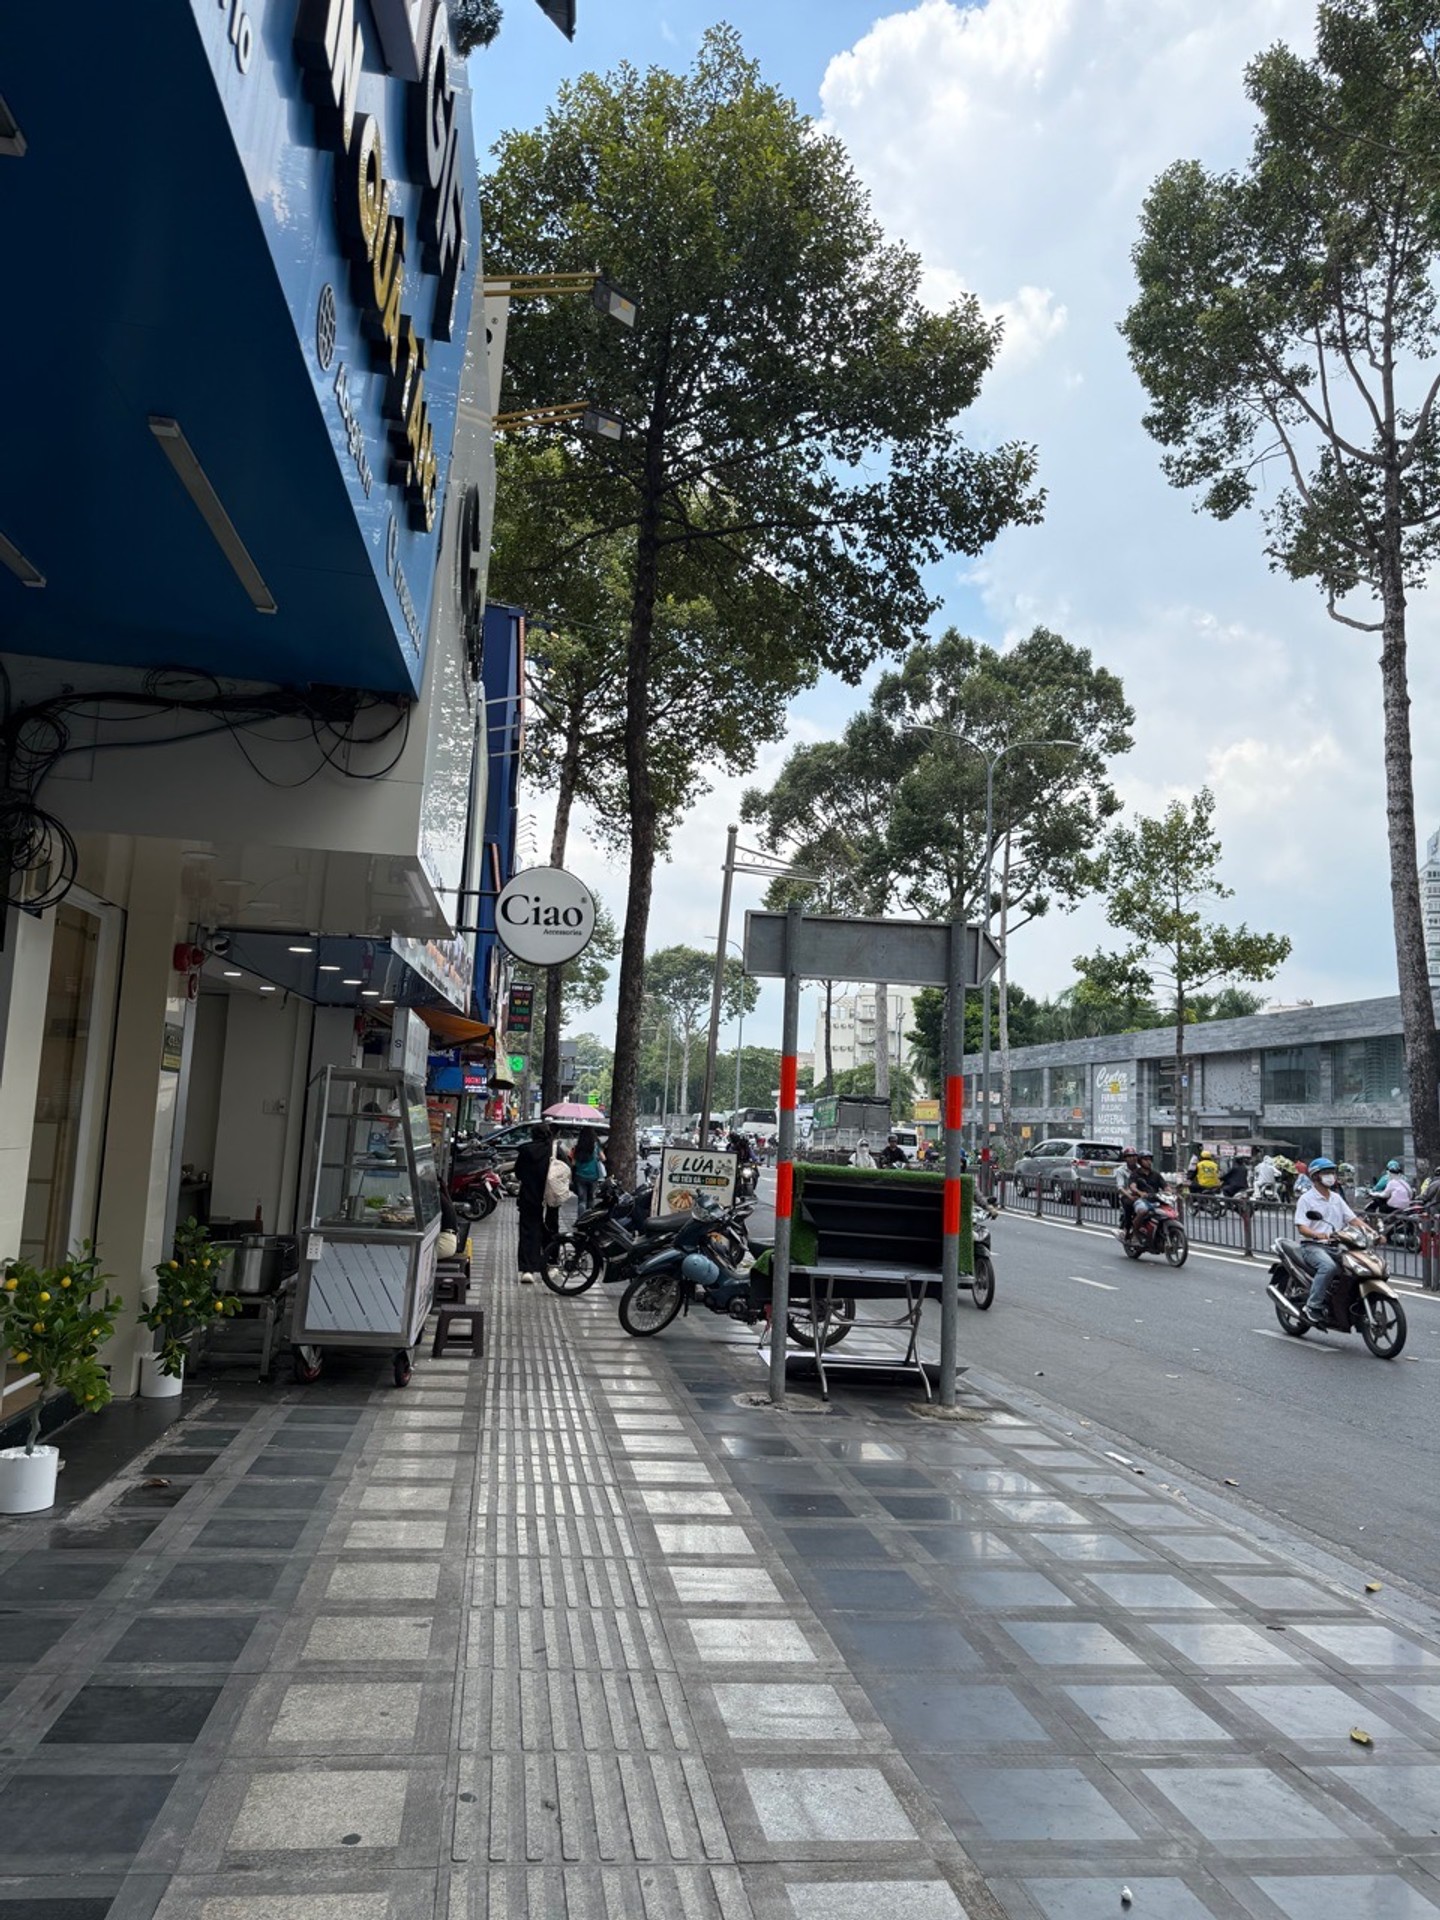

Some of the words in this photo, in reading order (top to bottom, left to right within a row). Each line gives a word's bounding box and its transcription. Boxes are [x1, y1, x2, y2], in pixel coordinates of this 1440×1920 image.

[501, 894, 583, 927] Ciao
[543, 928, 582, 936] Accessories
[682, 1155, 714, 1174] LÚA
